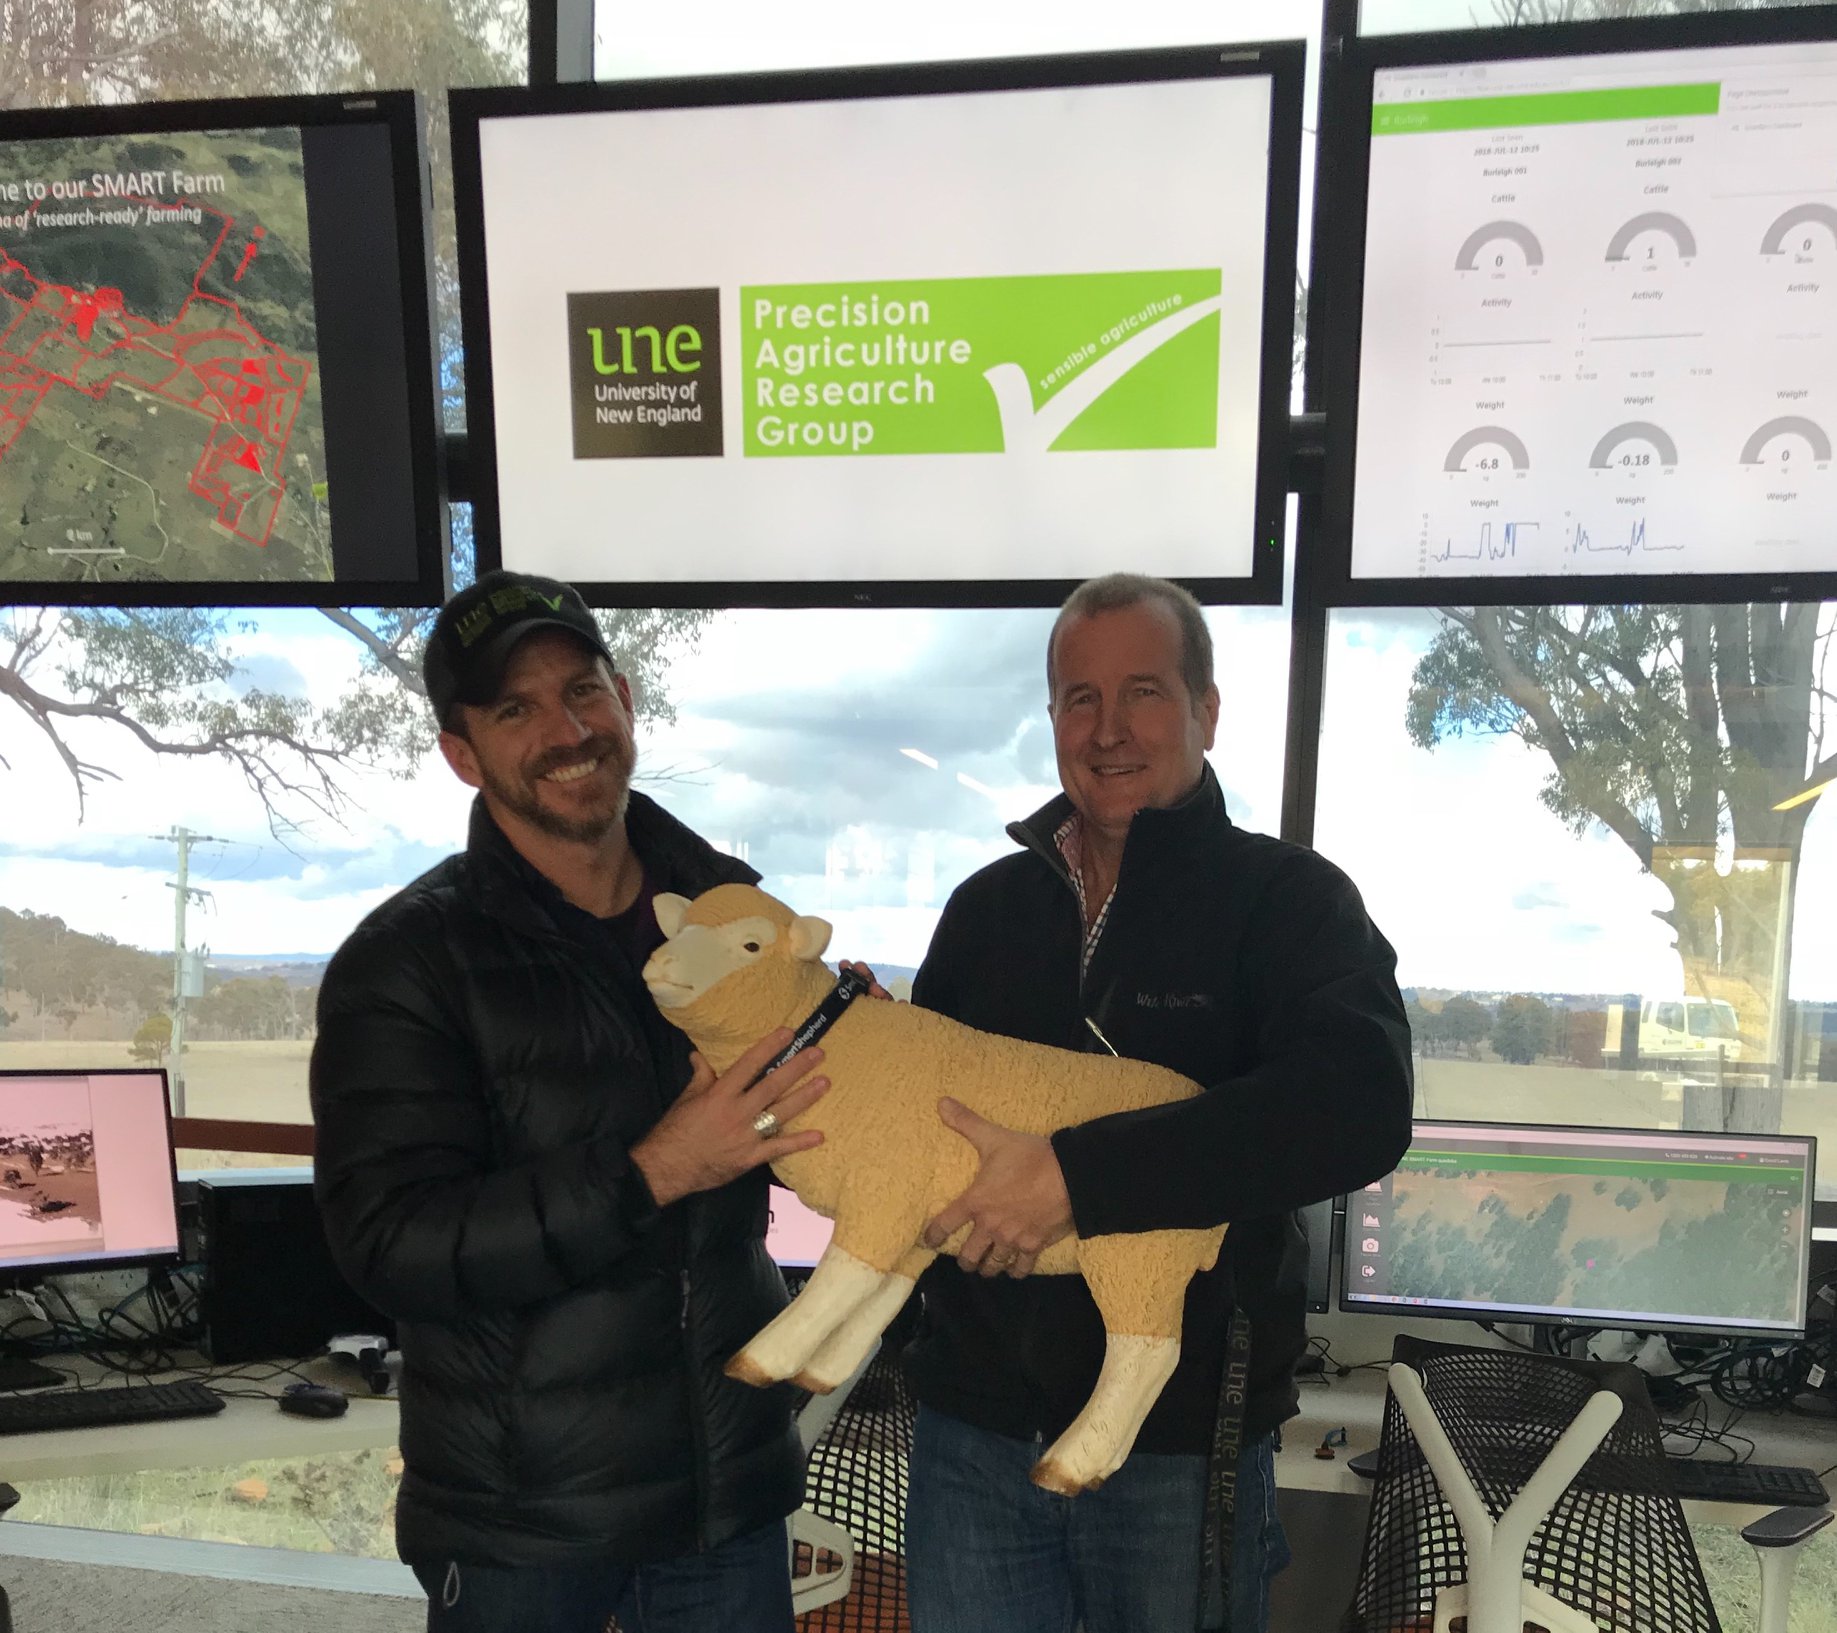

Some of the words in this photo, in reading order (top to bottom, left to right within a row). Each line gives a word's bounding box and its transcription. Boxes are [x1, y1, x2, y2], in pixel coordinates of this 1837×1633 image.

[25, 179, 46, 200] to
[52, 178, 87, 198] our
[92, 171, 166, 197] SMART
[172, 171, 225, 194] Farm
[1643, 185, 1669, 194] Cattle
[1491, 194, 1515, 203] Cattle
[15, 211, 30, 231] of
[145, 206, 201, 226] farming
[1802, 239, 1812, 251] 0
[1646, 247, 1654, 260] 1
[1495, 255, 1504, 267] 0
[1786, 284, 1820, 294] Activity
[1632, 291, 1663, 301] Activity
[1481, 298, 1512, 309] Activity
[755, 294, 930, 329] Precision
[1040, 342, 1097, 390] sensible
[1100, 293, 1183, 345] agriculture
[587, 324, 703, 375] une
[755, 333, 972, 376] Agriculture
[594, 382, 677, 403] University
[679, 380, 699, 401] of
[756, 372, 936, 407] Research
[1777, 389, 1808, 400] Weight
[1476, 401, 1505, 411] Weight
[1623, 396, 1654, 406] Weight
[596, 406, 633, 424] New
[636, 404, 702, 427] England
[756, 416, 875, 451] Group
[1617, 454, 1650, 467] -0.18
[1781, 449, 1790, 462] 0
[1475, 458, 1499, 470] -6.8
[1616, 496, 1646, 507] Weight
[1766, 492, 1797, 502] Weight
[1470, 499, 1499, 509] Weight
[1226, 1362, 1247, 1405] une
[1221, 1416, 1242, 1460] une
